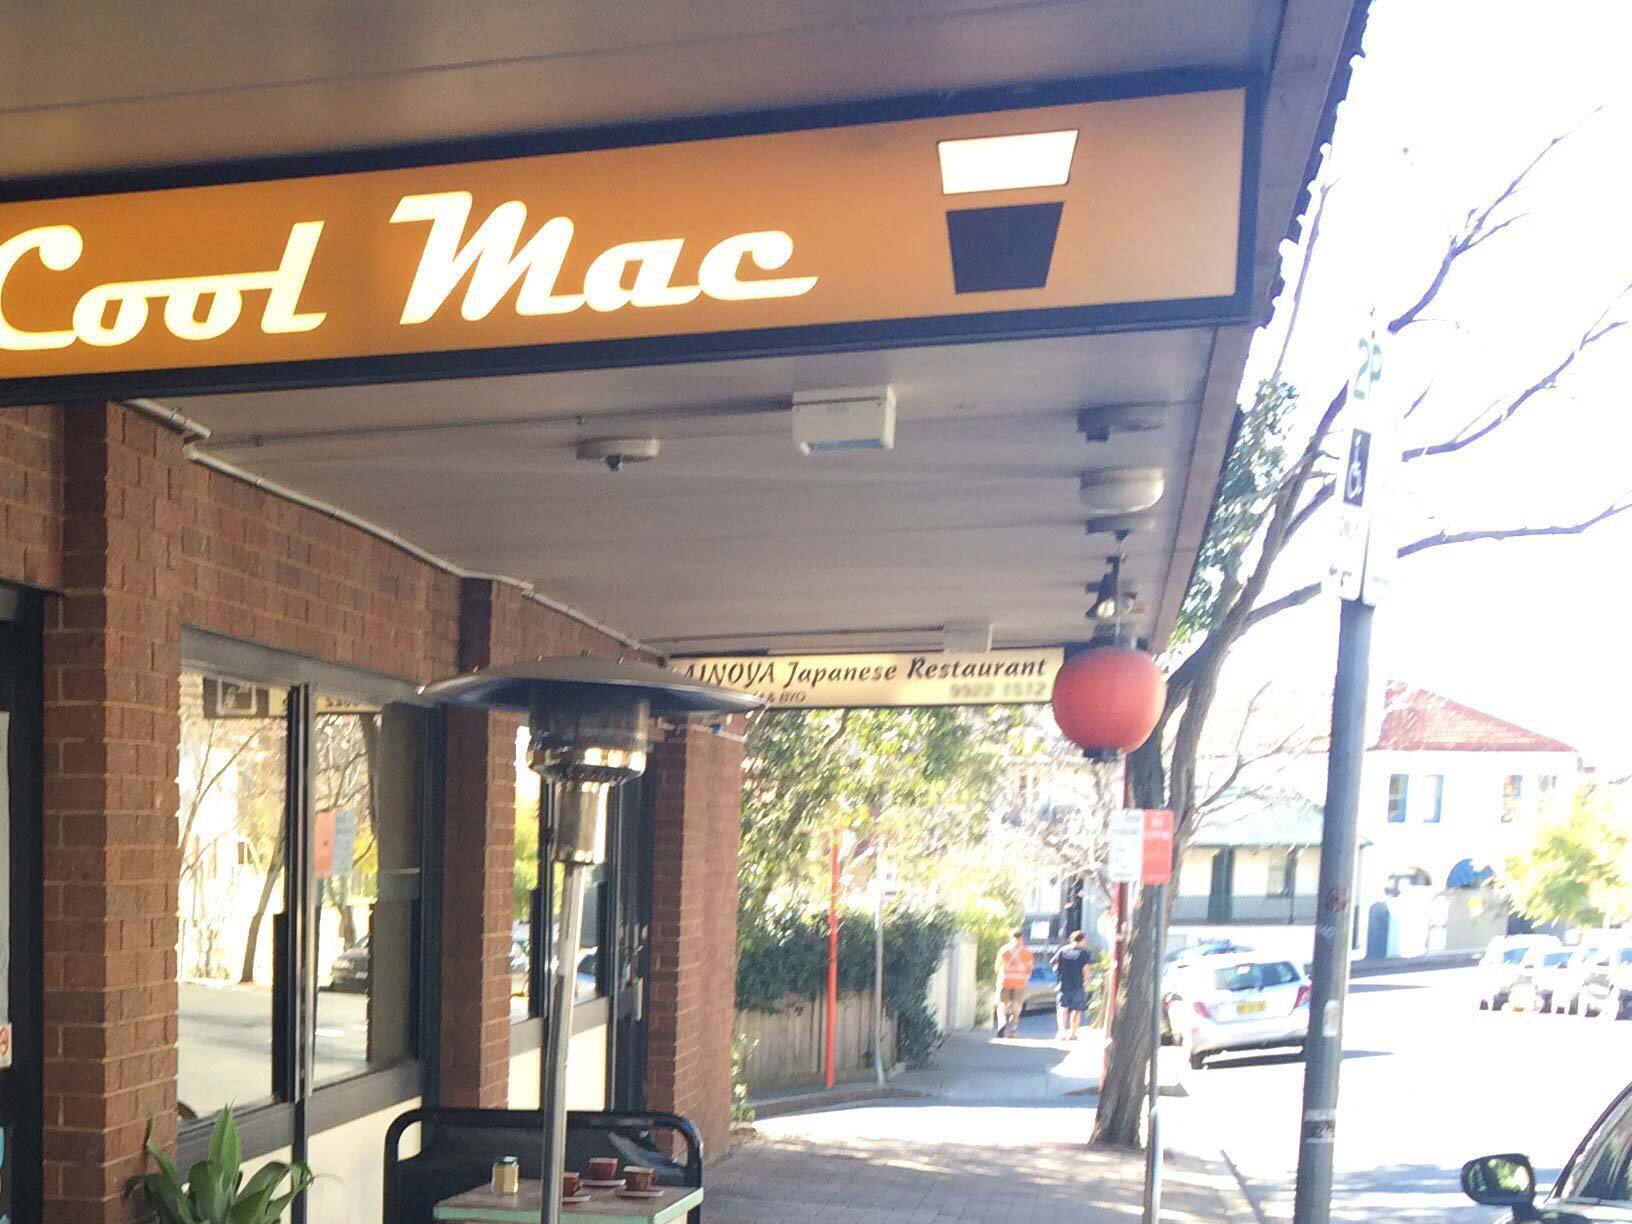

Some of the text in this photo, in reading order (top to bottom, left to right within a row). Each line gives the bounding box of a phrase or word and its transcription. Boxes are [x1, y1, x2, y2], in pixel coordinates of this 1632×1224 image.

[388, 190, 820, 324] Mac
[783, 660, 898, 689] Japanese
[906, 656, 1048, 680] Restaurant
